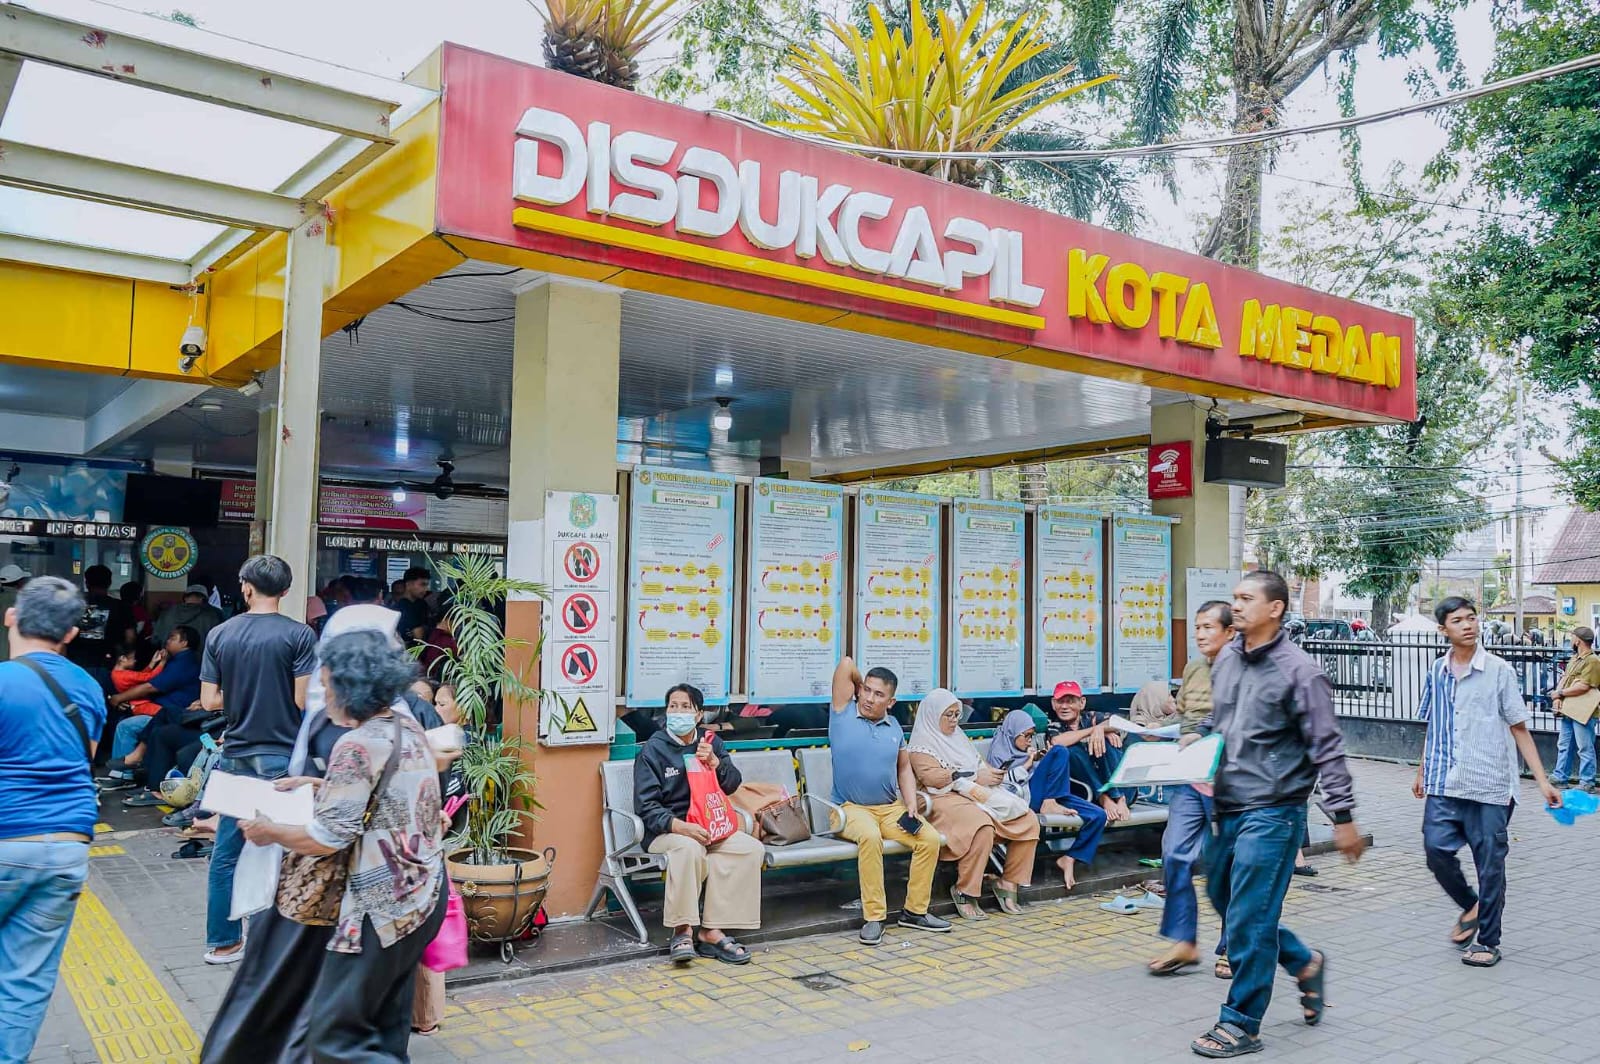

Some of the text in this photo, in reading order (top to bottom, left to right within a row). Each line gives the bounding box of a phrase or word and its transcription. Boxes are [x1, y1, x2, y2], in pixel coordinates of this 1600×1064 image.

[513, 106, 1401, 388] DISDUKCAPIL KOTA MEDAN
[46, 522, 137, 539] INFORMASI
